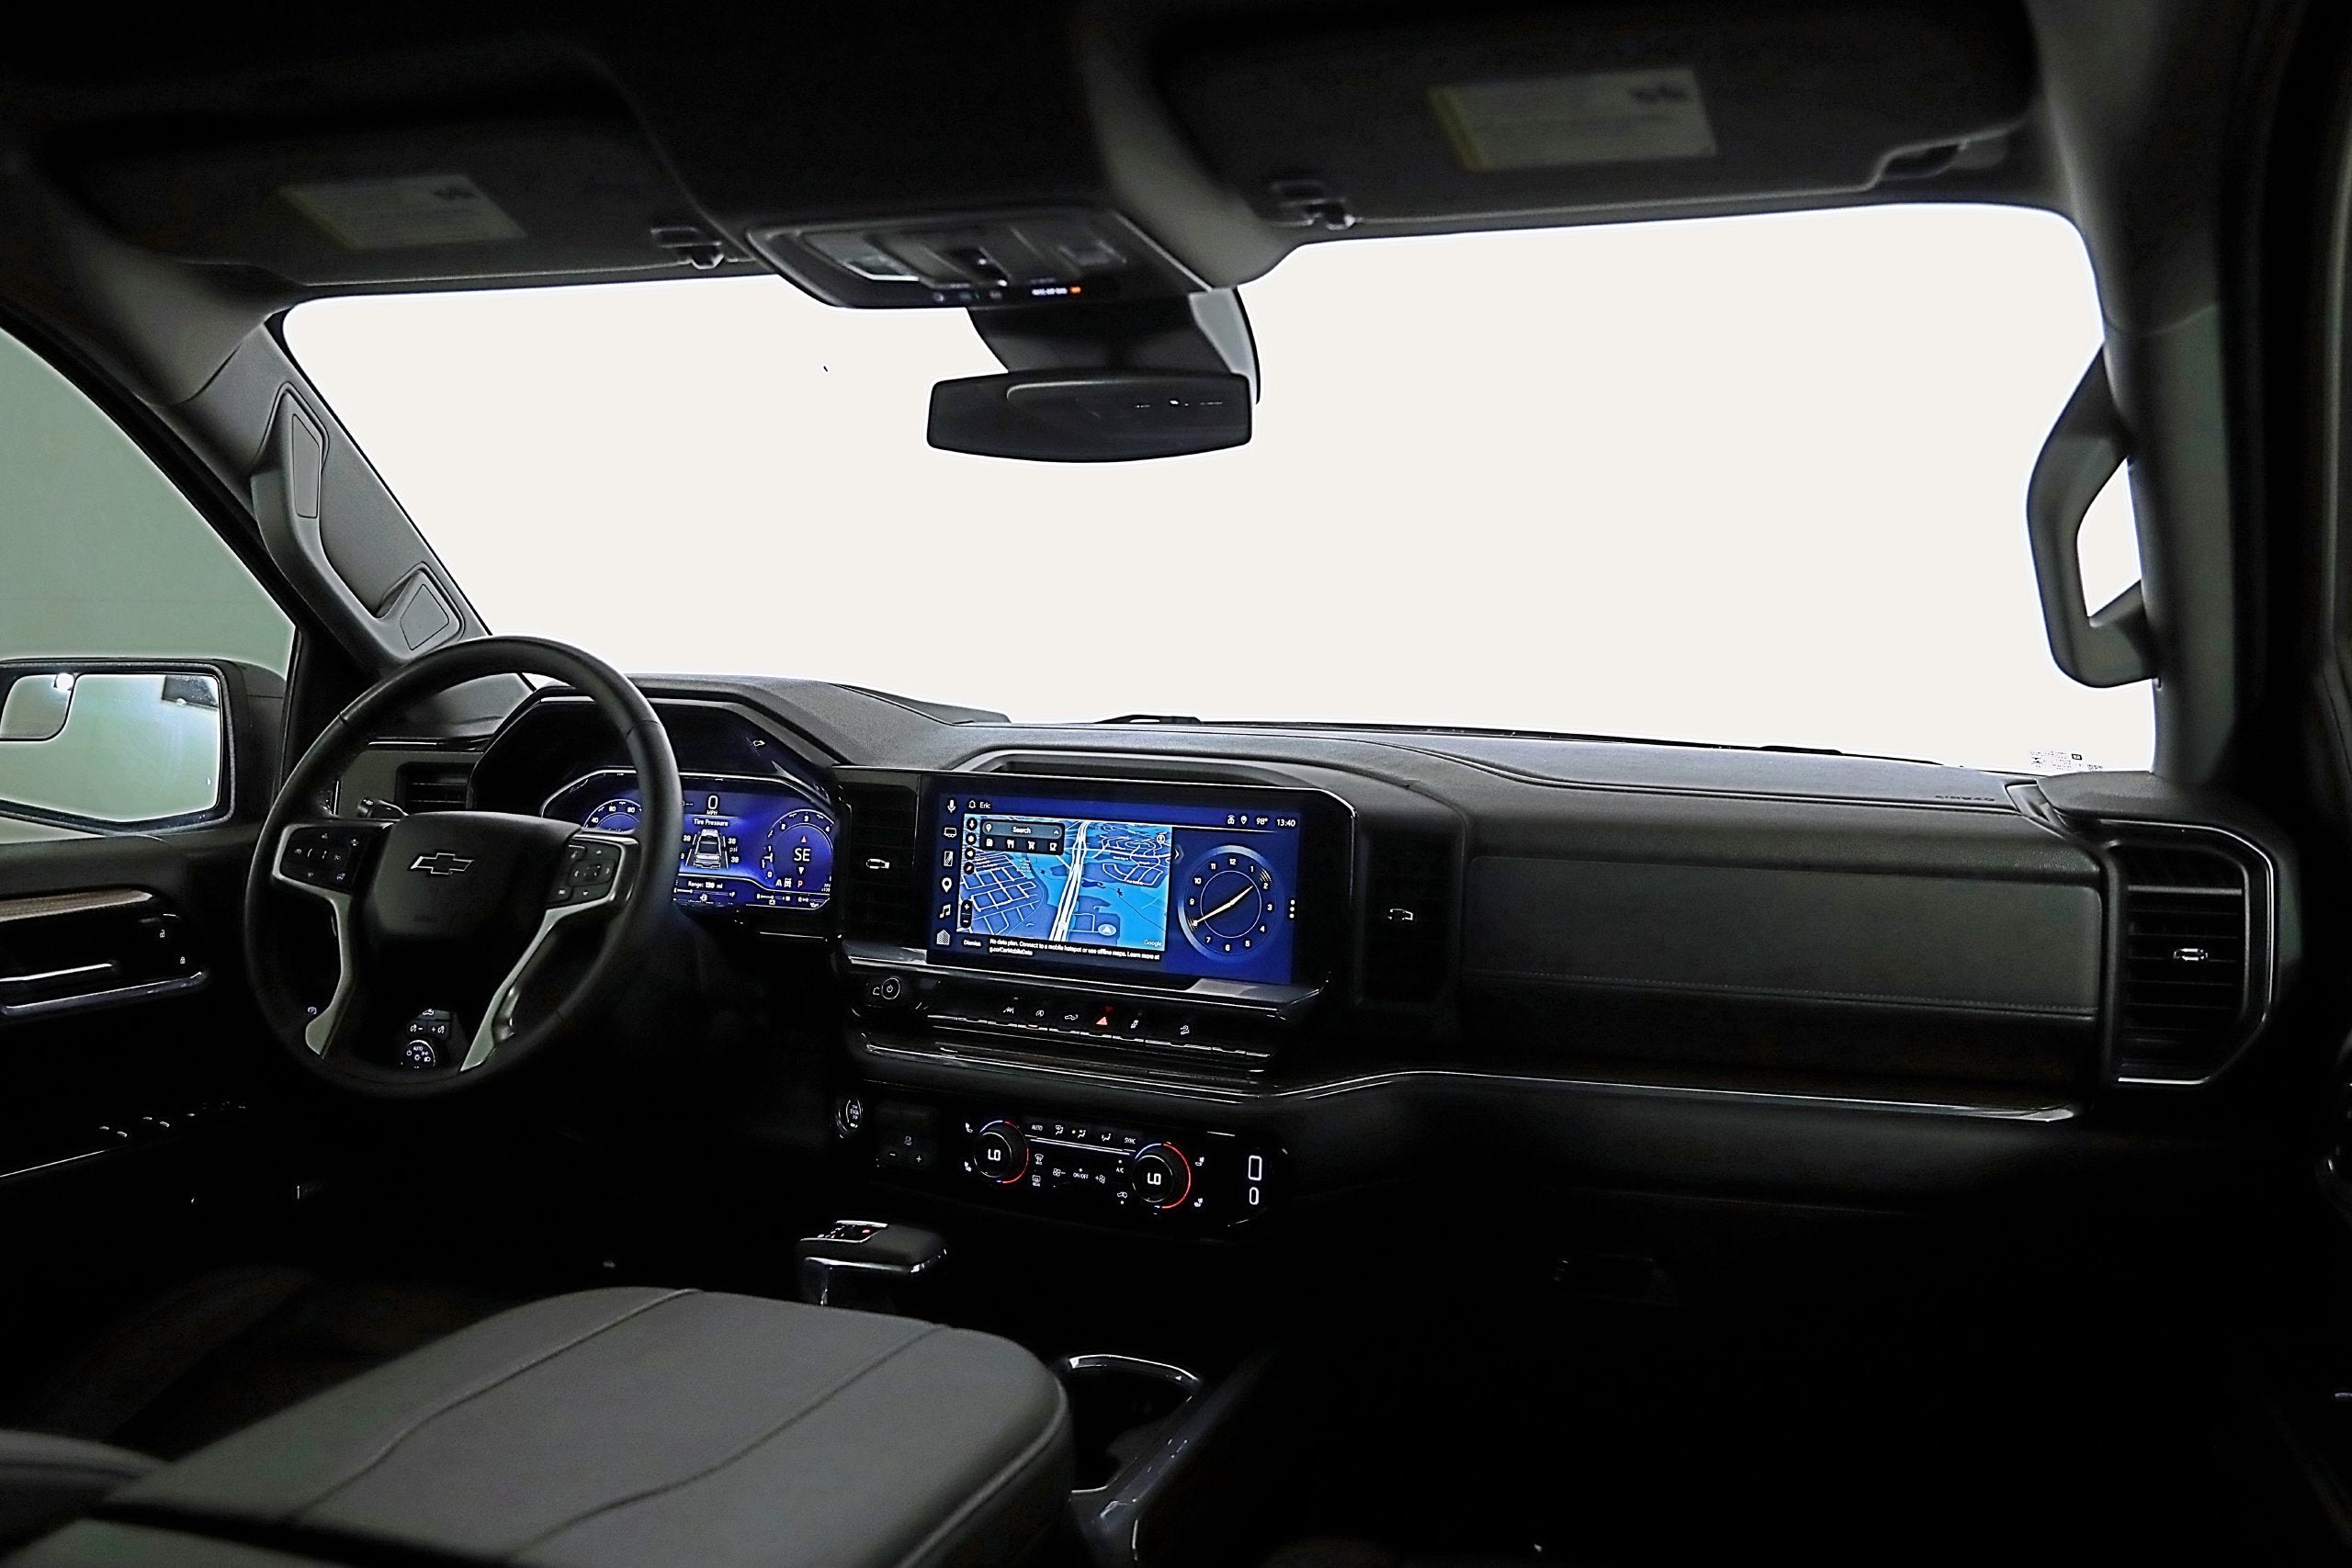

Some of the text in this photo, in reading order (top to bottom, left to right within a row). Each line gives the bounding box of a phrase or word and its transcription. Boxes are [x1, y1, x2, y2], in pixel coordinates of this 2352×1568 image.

[708, 795, 718, 809] 0
[1277, 818, 1296, 827] 13:40
[1012, 826, 1032, 834] Search
[794, 847, 811, 862] SE
[687, 881, 705, 889] Range:
[797, 879, 804, 888] P
[1193, 876, 1202, 885] 10
[1189, 897, 1195, 906] 9
[1267, 903, 1273, 911] 3
[1143, 939, 1163, 948] Google
[1225, 943, 1231, 952] 6
[1244, 940, 1251, 948] 5
[1019, 941, 1039, 949] Connect
[1064, 945, 1082, 953] hotspot
[1113, 950, 1127, 958] maps.
[1127, 951, 1141, 959] Learn
[1124, 1136, 1136, 1145] SYNC
